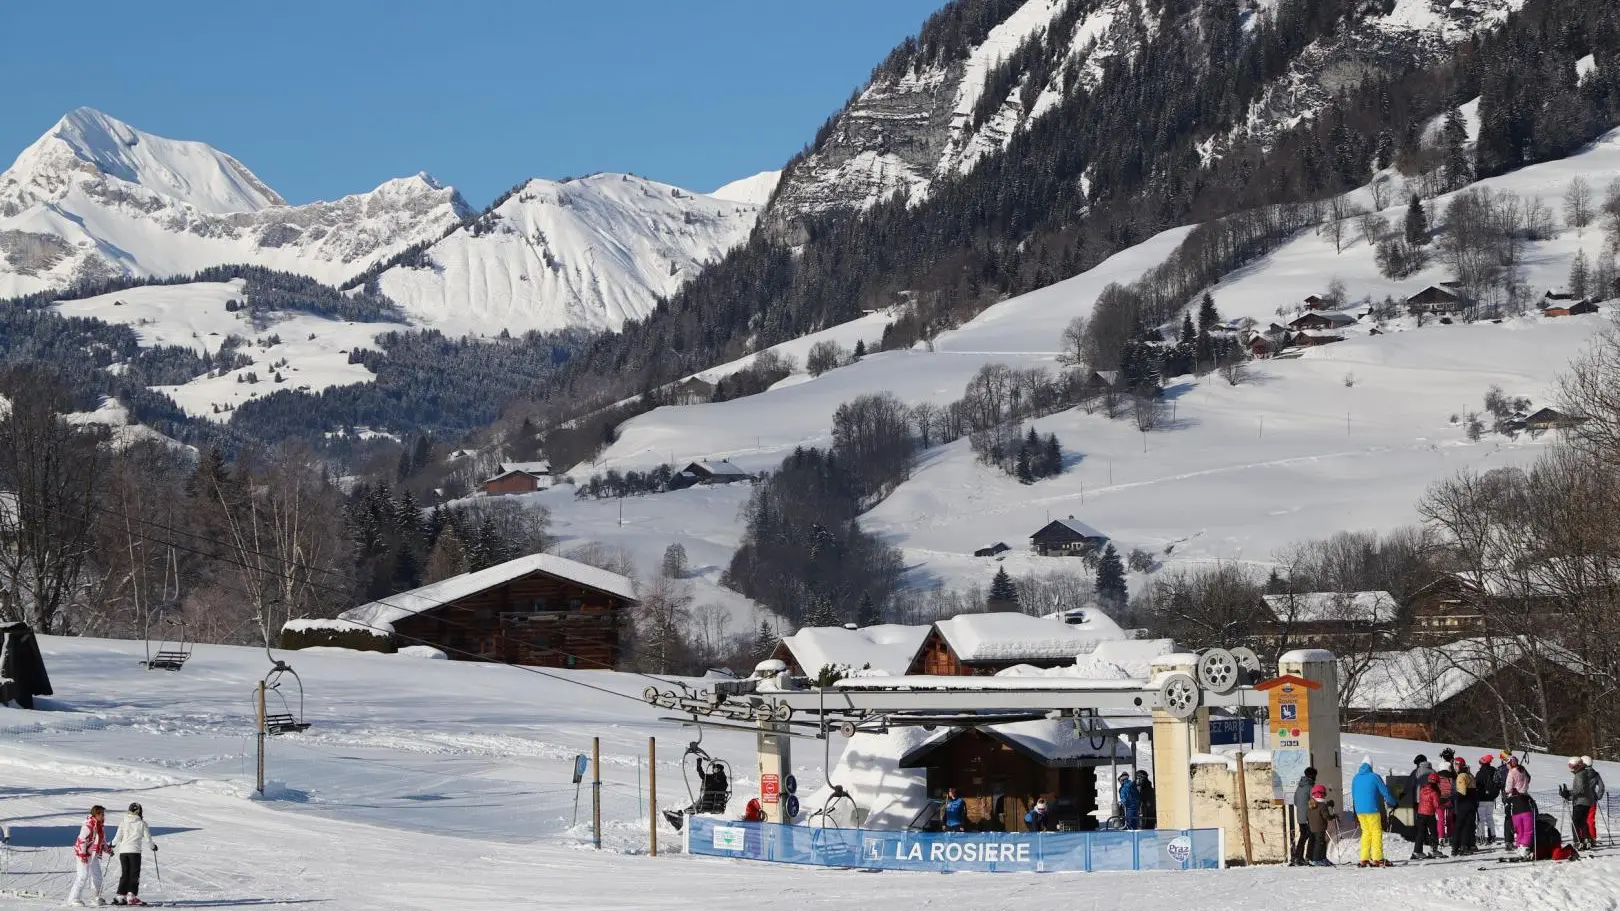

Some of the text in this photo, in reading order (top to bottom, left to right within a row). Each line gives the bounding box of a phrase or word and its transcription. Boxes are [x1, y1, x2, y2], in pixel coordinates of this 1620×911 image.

[895, 842, 1030, 862] LA ROSIERE
[1169, 844, 1190, 853] Praz
